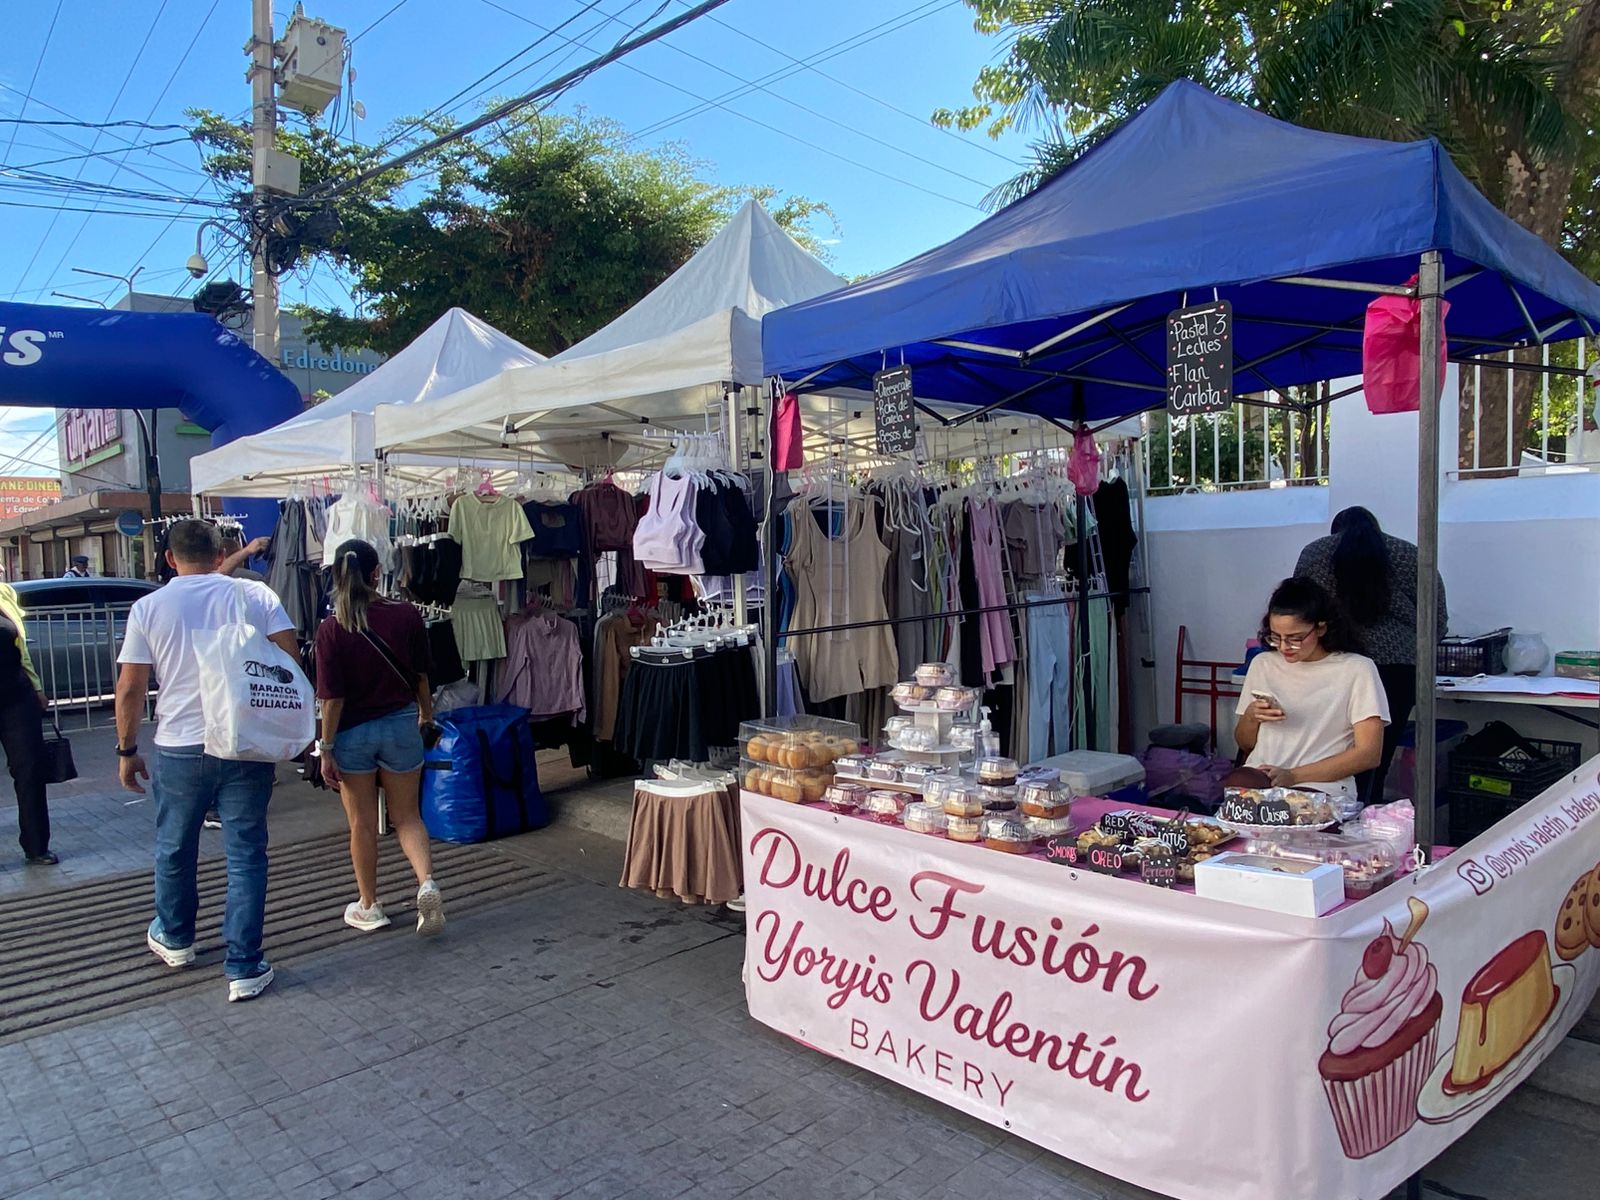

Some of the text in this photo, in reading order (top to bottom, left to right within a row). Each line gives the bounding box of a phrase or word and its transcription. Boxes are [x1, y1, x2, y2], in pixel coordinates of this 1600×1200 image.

[1174, 313, 1227, 342] Pastel 3
[1177, 336, 1221, 358] Leches
[1172, 363, 1210, 383] Flan
[1173, 382, 1224, 410] Carlota
[1105, 814, 1125, 828] RED
[1090, 848, 1122, 869] OREO
[750, 827, 1160, 1001] Dulce Fusión
[755, 909, 1151, 1103] Yoryis Valentín
[849, 1017, 1015, 1108] BAKERY
